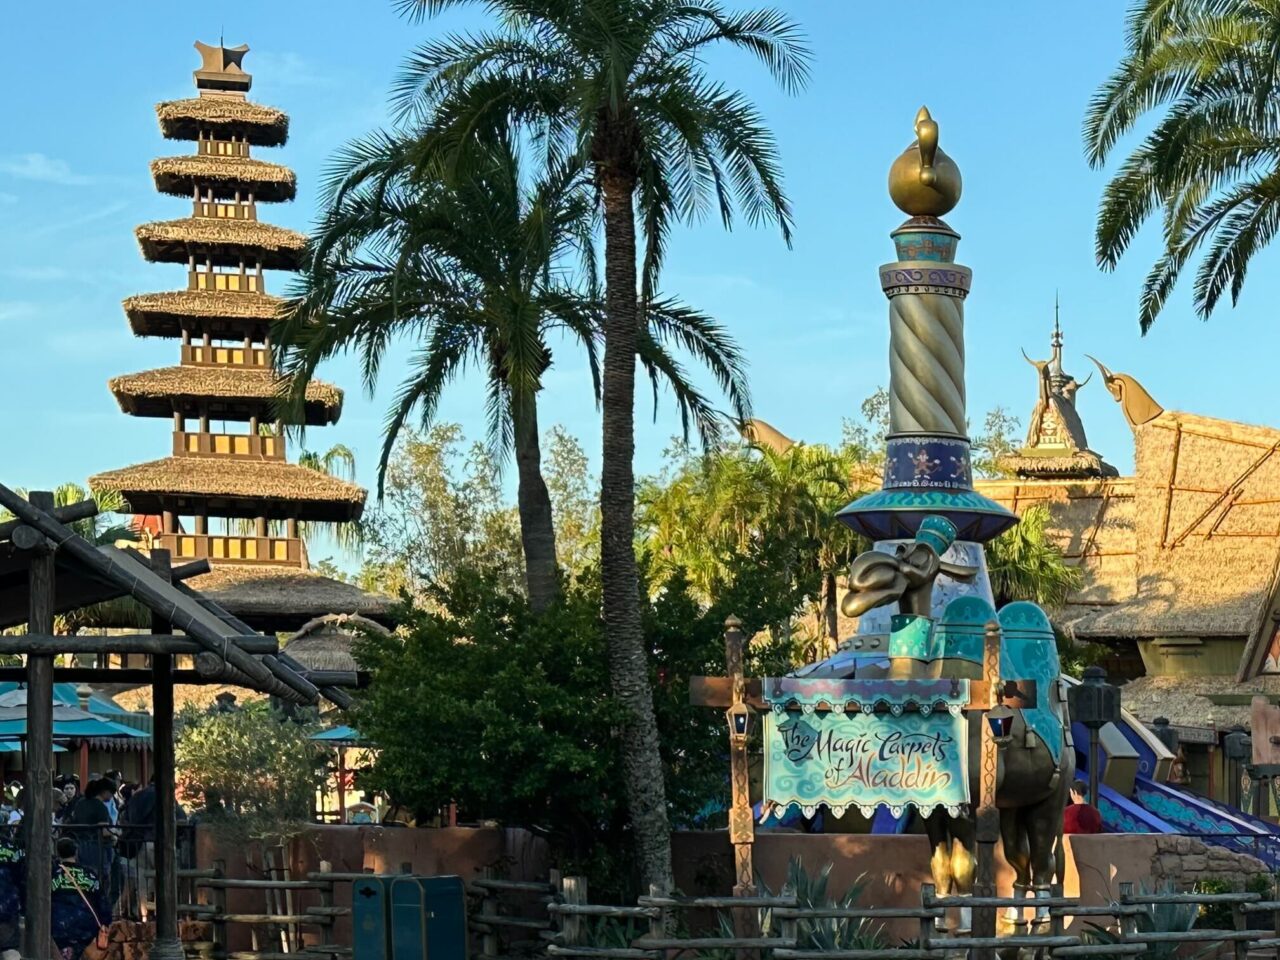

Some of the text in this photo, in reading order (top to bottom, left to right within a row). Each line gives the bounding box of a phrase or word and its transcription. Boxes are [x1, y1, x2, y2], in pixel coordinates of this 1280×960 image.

[776, 722, 953, 768] The Magic Carpets
[824, 752, 952, 789] of Aladdin
